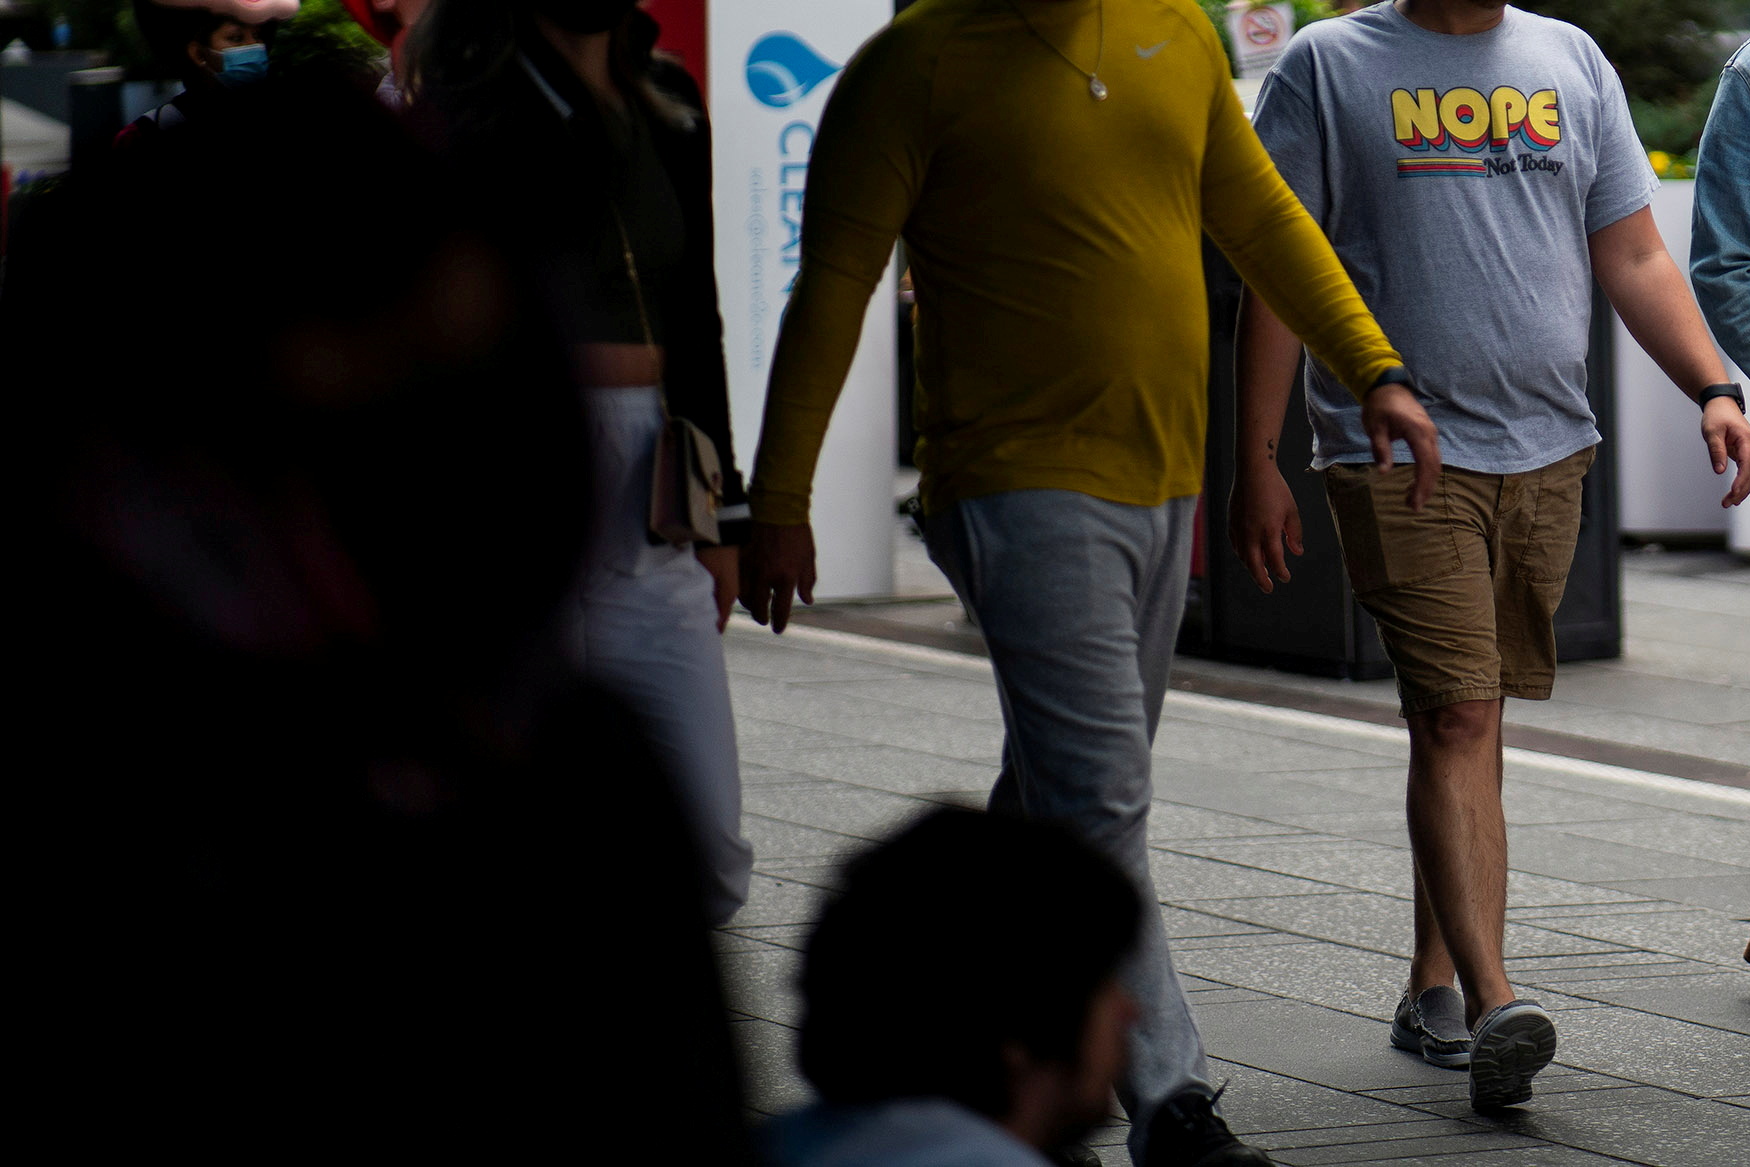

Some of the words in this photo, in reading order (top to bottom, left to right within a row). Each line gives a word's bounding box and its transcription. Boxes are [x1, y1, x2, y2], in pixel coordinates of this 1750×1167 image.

[1391, 85, 1561, 152] NOPE
[1484, 156, 1517, 178] Not
[1517, 152, 1564, 176] Today
